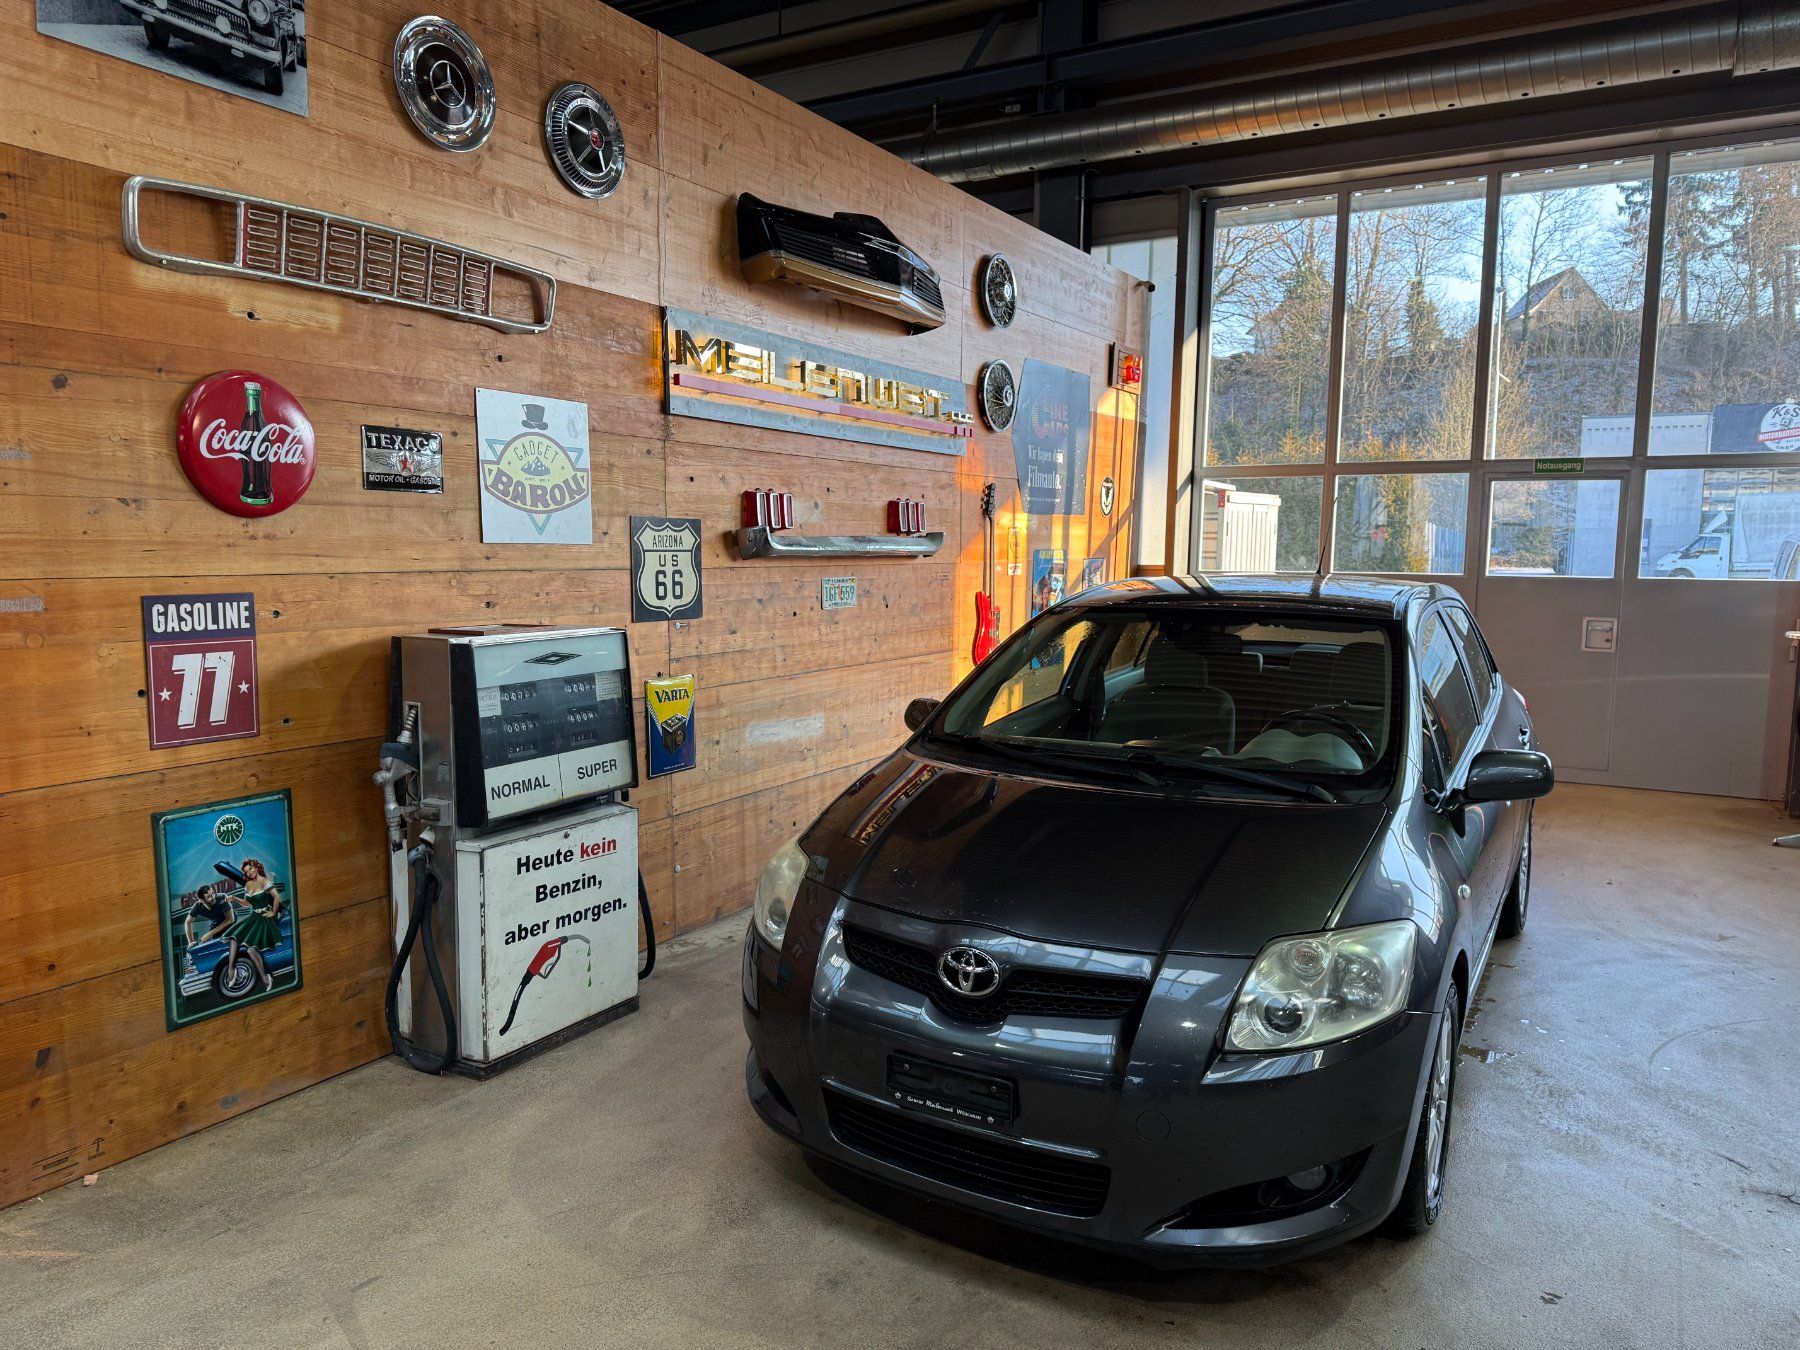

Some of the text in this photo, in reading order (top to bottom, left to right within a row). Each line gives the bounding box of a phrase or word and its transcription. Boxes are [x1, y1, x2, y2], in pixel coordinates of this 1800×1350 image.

[200, 419, 304, 464] Coca-Cola
[366, 432, 440, 453] TEXACO
[513, 440, 559, 464] GADGET
[1536, 462, 1582, 471] Notausgang
[368, 475, 394, 483] MOTOR
[394, 475, 406, 484] OIL
[490, 467, 586, 510] BARON
[652, 535, 684, 548] ARIZONA
[655, 569, 684, 601] 66
[151, 601, 251, 633] GASOLINE
[655, 688, 690, 704] VARTA
[577, 758, 618, 780] SUPER
[491, 774, 551, 801] NORMAL
[220, 822, 239, 833] NTK
[516, 837, 617, 876] Heute kein
[535, 873, 603, 903] Benzin,
[504, 897, 627, 945] aber morgen.
